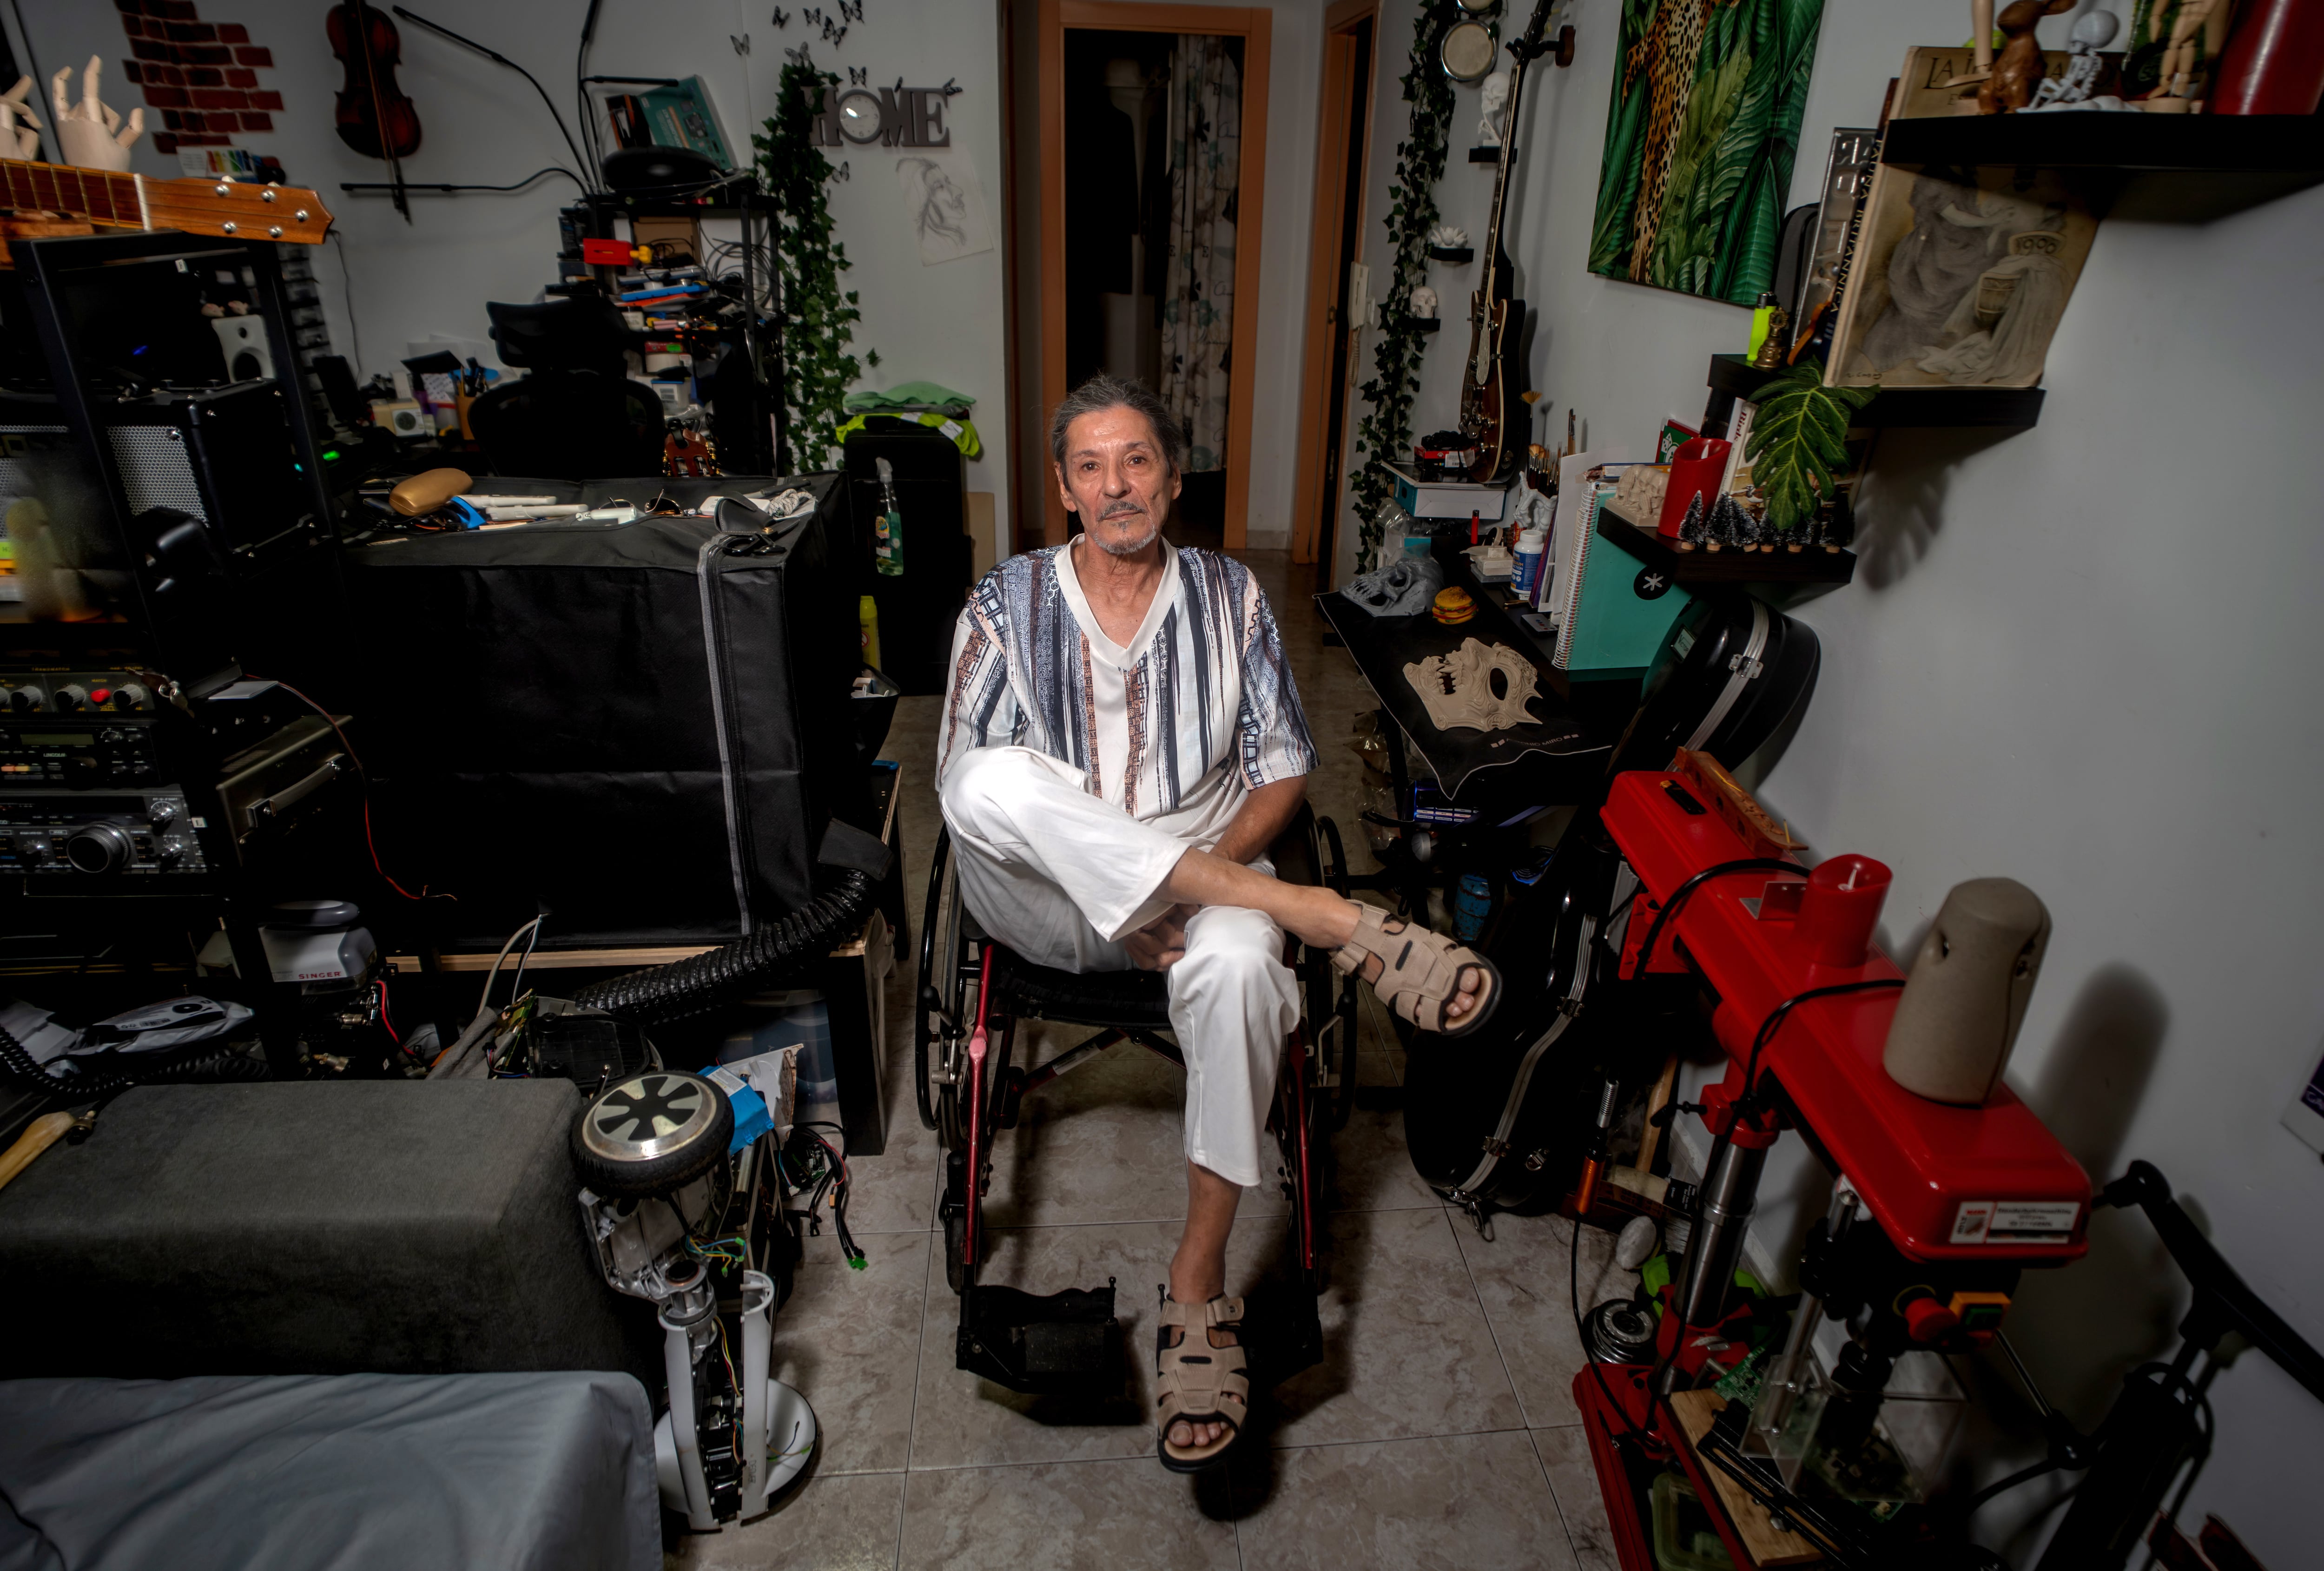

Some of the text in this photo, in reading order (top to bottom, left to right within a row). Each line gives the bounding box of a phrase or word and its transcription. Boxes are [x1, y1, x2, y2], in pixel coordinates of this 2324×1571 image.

[799, 86, 950, 147] HOME
[1860, 139, 1882, 199] FAUNA
[1830, 209, 1864, 313] BRITANNICA
[1734, 411, 1747, 442] Birds
[1541, 737, 1563, 746] MIRO
